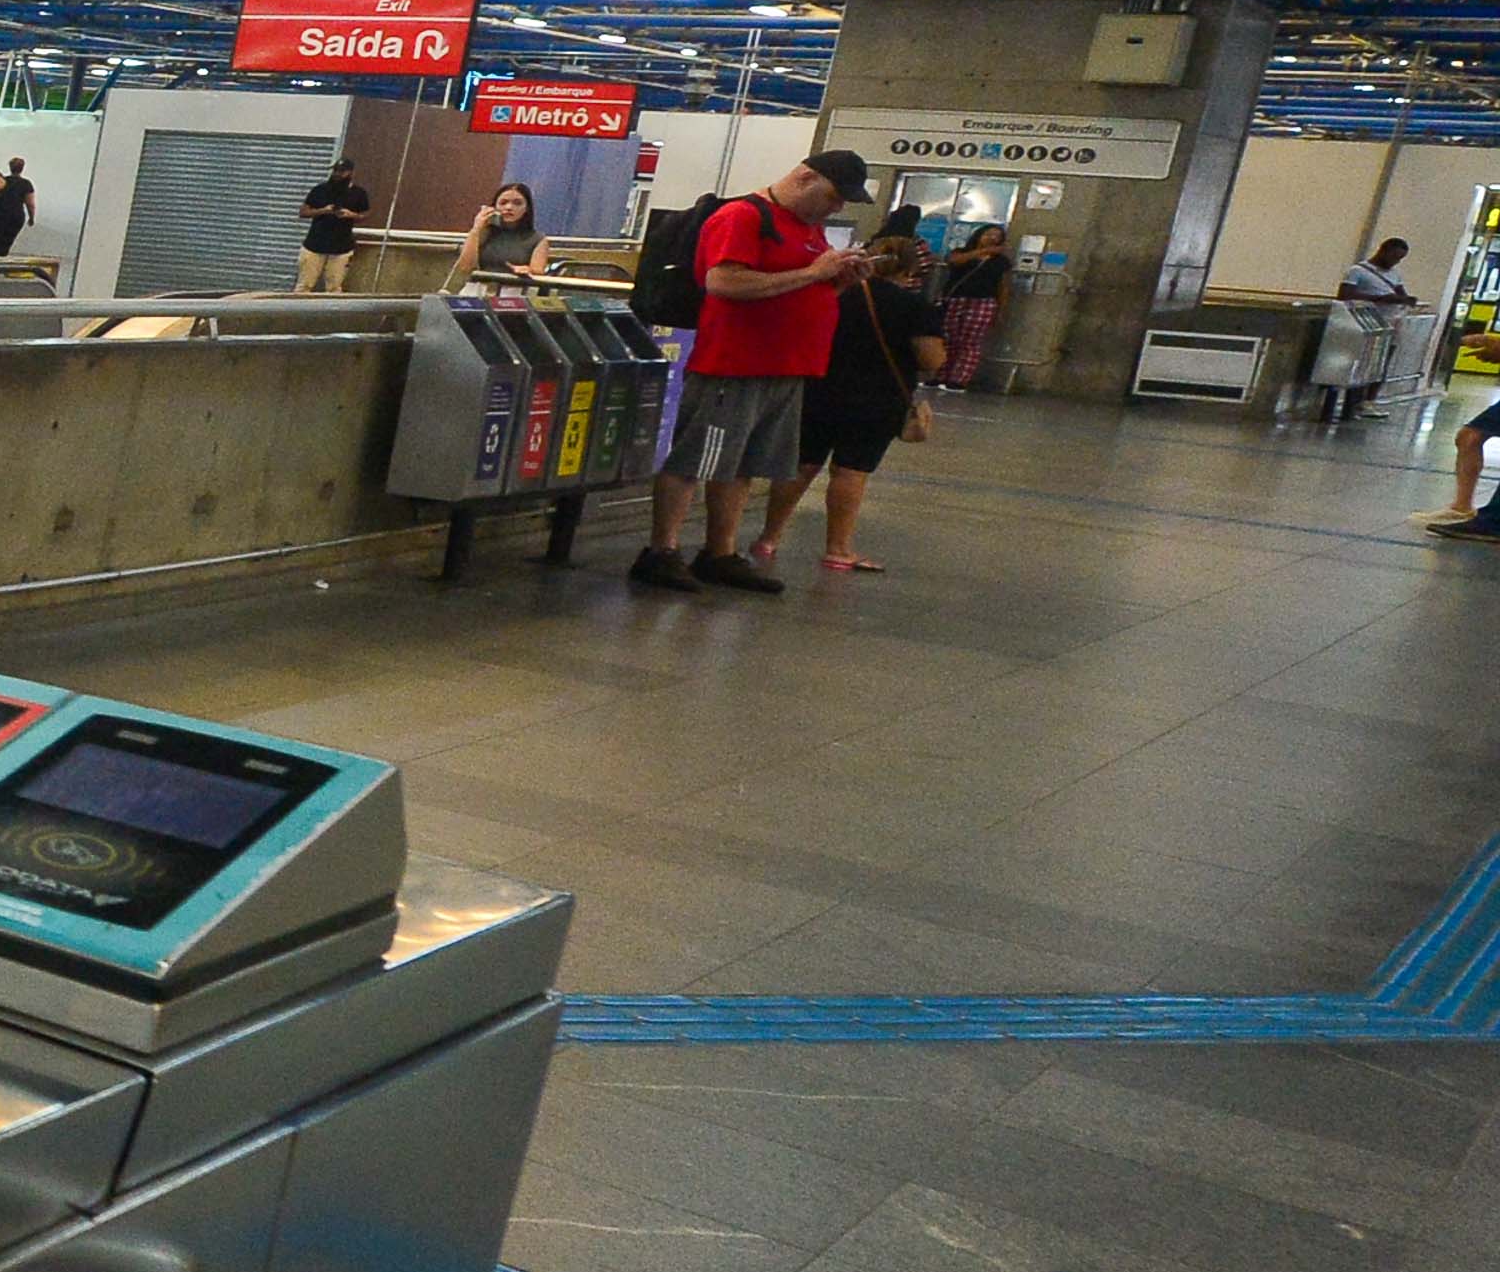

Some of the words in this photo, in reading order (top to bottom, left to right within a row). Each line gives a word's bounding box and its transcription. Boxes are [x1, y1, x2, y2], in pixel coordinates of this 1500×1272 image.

[300, 28, 403, 59] Saída
[535, 86, 595, 98] Embarque
[515, 106, 589, 127] Metrô
[962, 119, 1033, 133] Embarque
[1047, 123, 1114, 137] Boarding
